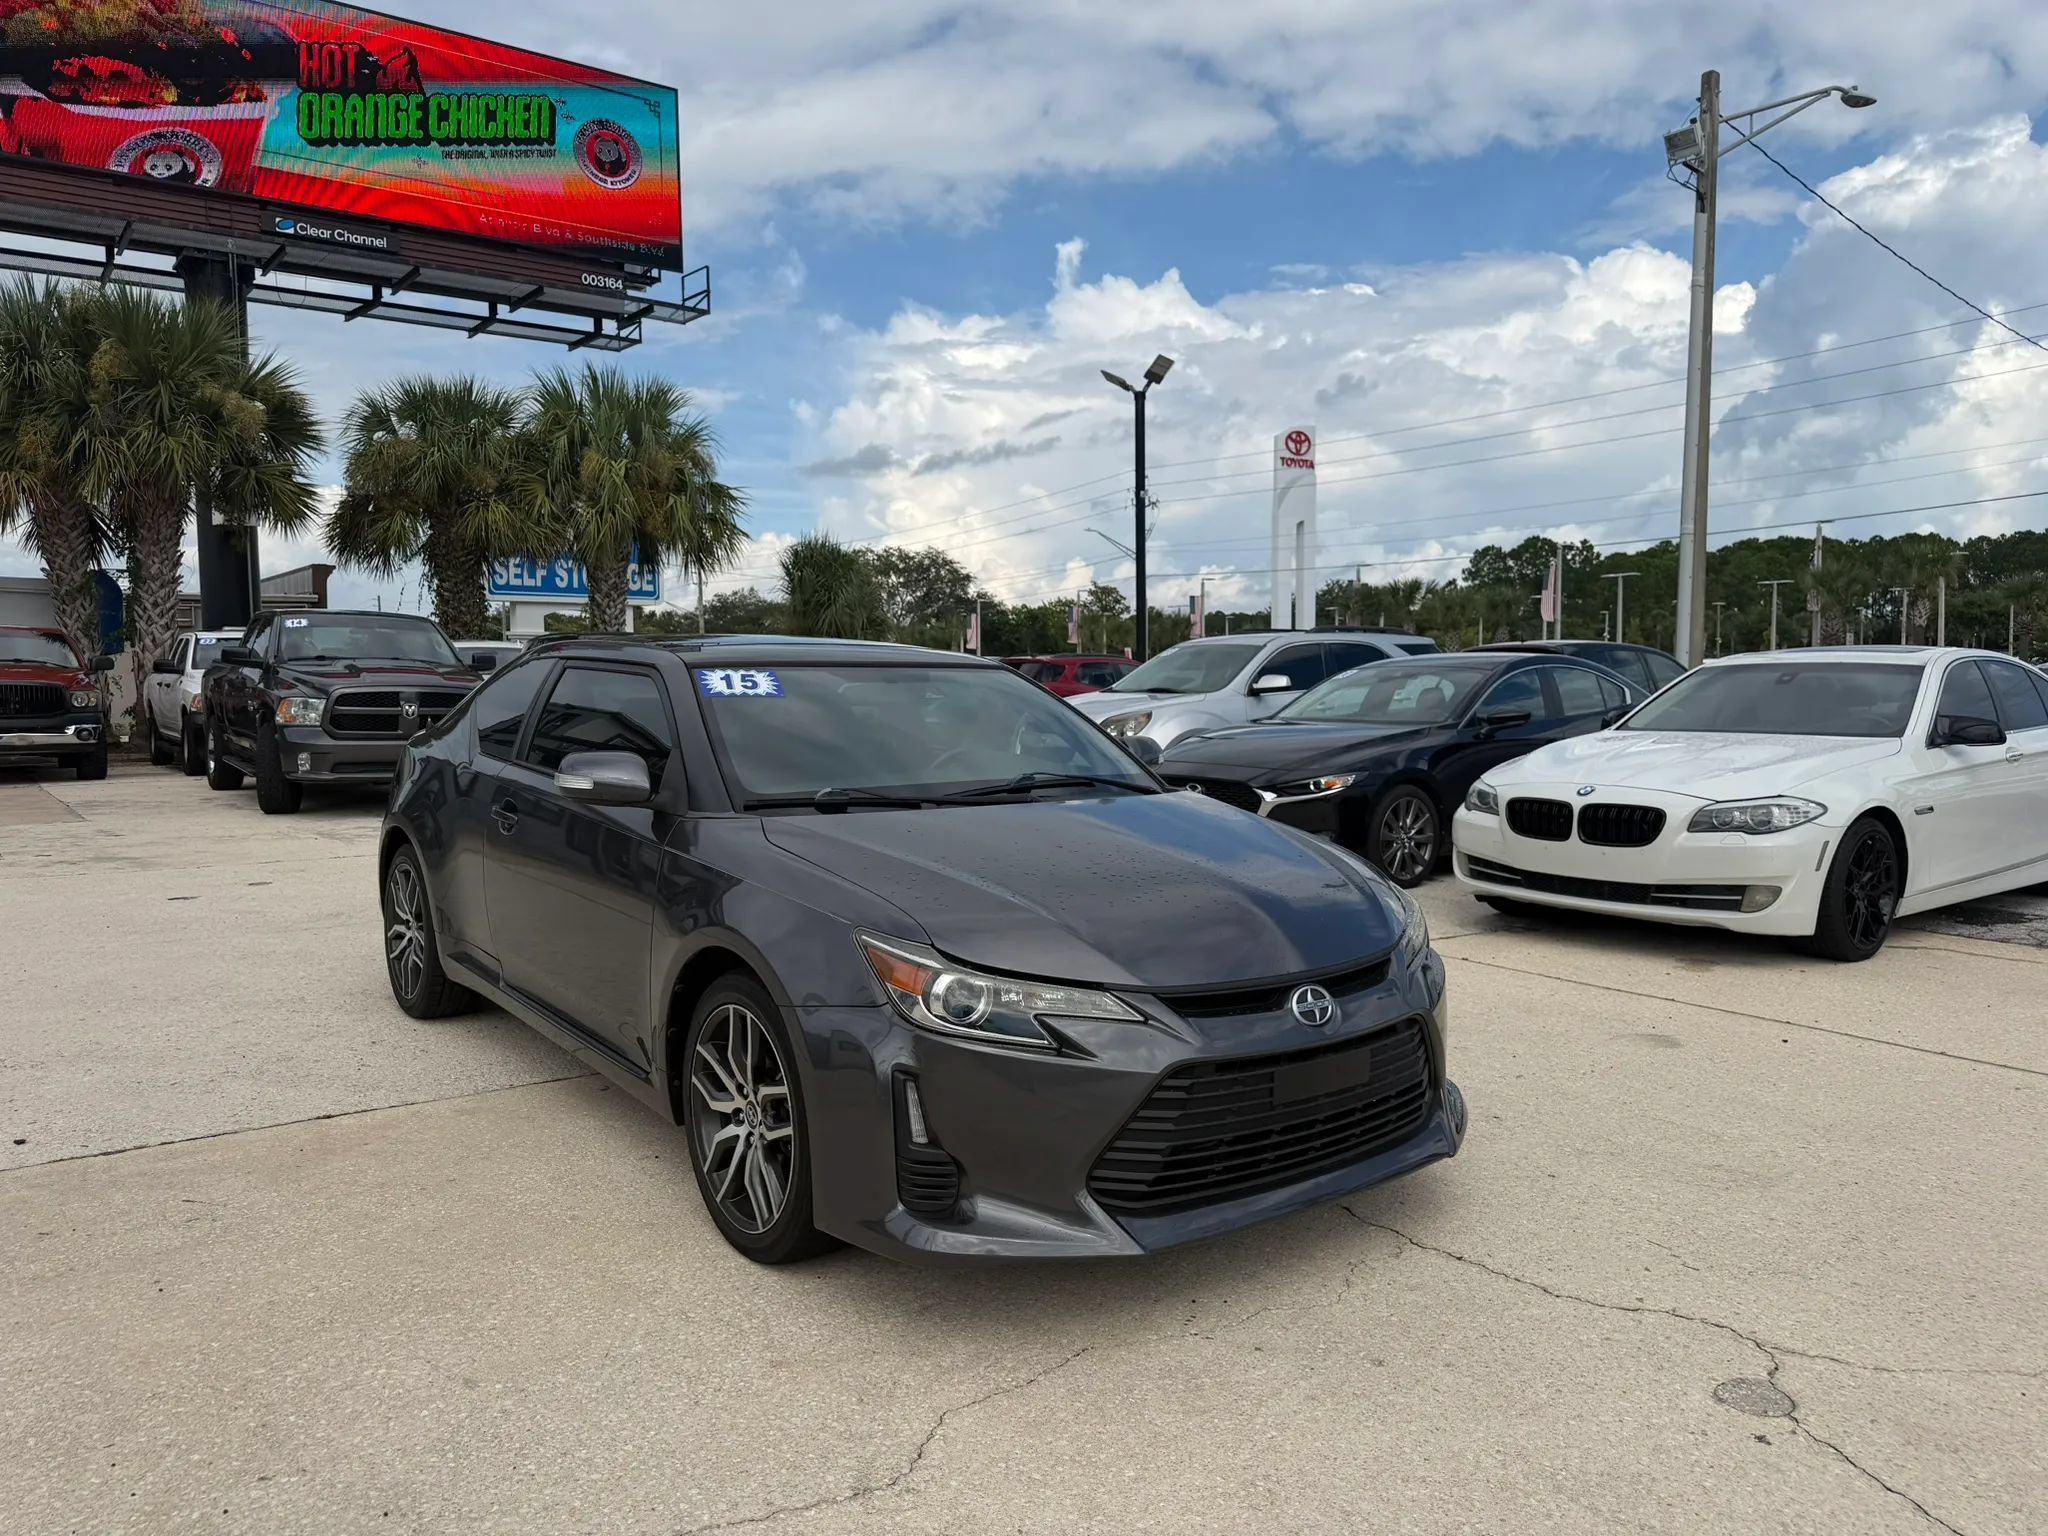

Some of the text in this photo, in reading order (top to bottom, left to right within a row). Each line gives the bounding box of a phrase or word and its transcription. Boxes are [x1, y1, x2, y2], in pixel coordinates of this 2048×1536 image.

[300, 43, 360, 88] HOT
[300, 92, 550, 139] ORANGE CHICKEN
[296, 222, 388, 248] Clear Channel
[581, 273, 624, 290] 003164
[1280, 456, 1315, 470] TOYOTA
[494, 557, 547, 587] SELF
[720, 673, 758, 690] 15
